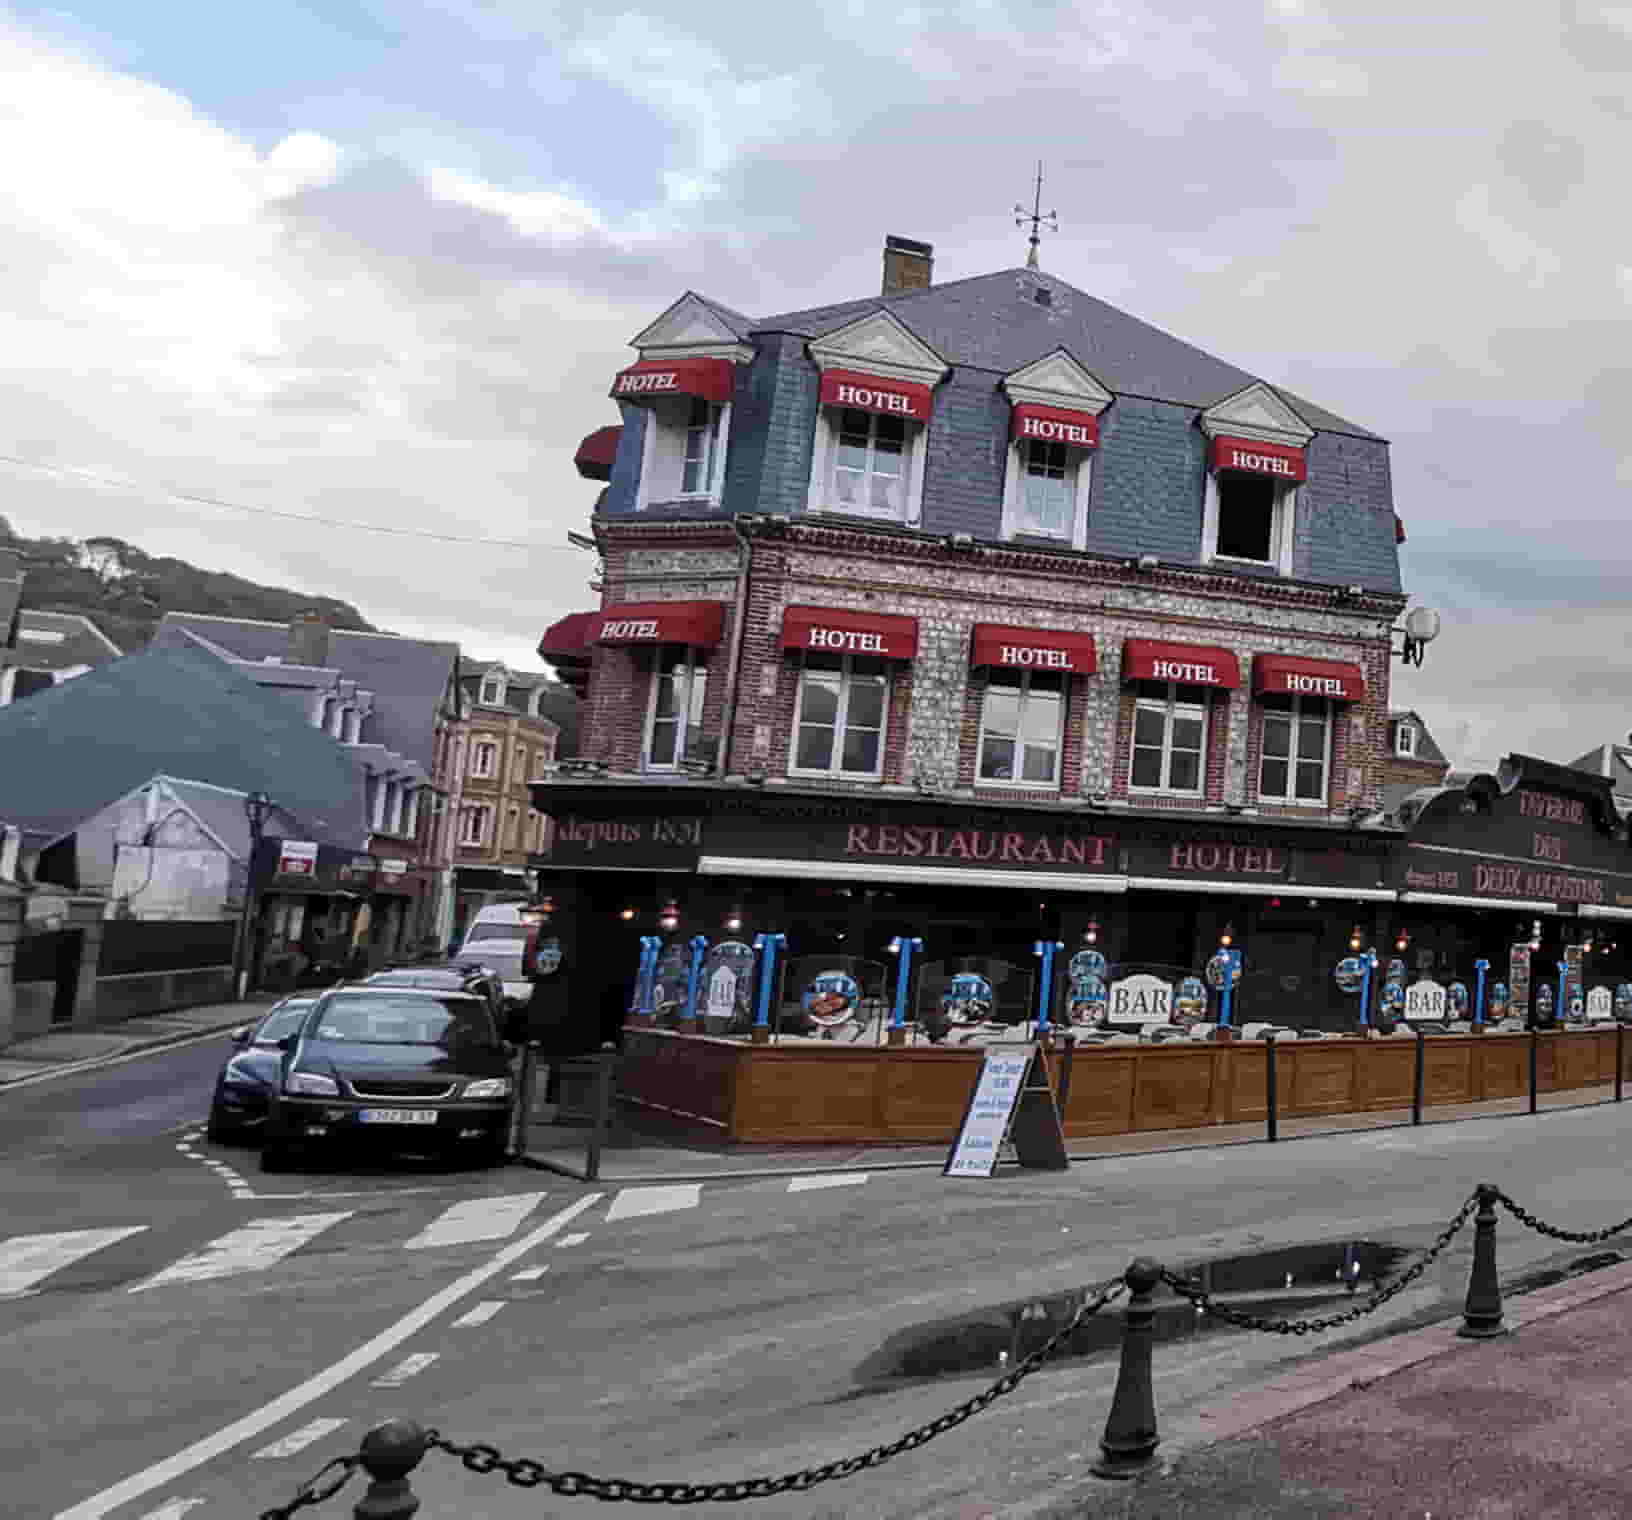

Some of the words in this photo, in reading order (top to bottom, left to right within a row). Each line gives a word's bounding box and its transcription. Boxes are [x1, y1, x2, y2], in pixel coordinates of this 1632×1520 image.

[617, 373, 679, 391] HOTEL
[838, 387, 916, 413] HOTEL
[1023, 418, 1094, 444] HOTEL
[1231, 451, 1296, 475] HOTEL
[601, 622, 660, 640] HOTEL
[808, 629, 890, 653] HOTEL
[1000, 646, 1074, 668] HOTEL
[1152, 661, 1220, 683] HOTEL
[1286, 673, 1347, 696] HOTEL
[846, 823, 1112, 866] RESTAURANT
[1169, 844, 1285, 873] HOTEL
[1113, 989, 1169, 1015] BAR
[1407, 992, 1443, 1010] BAR
